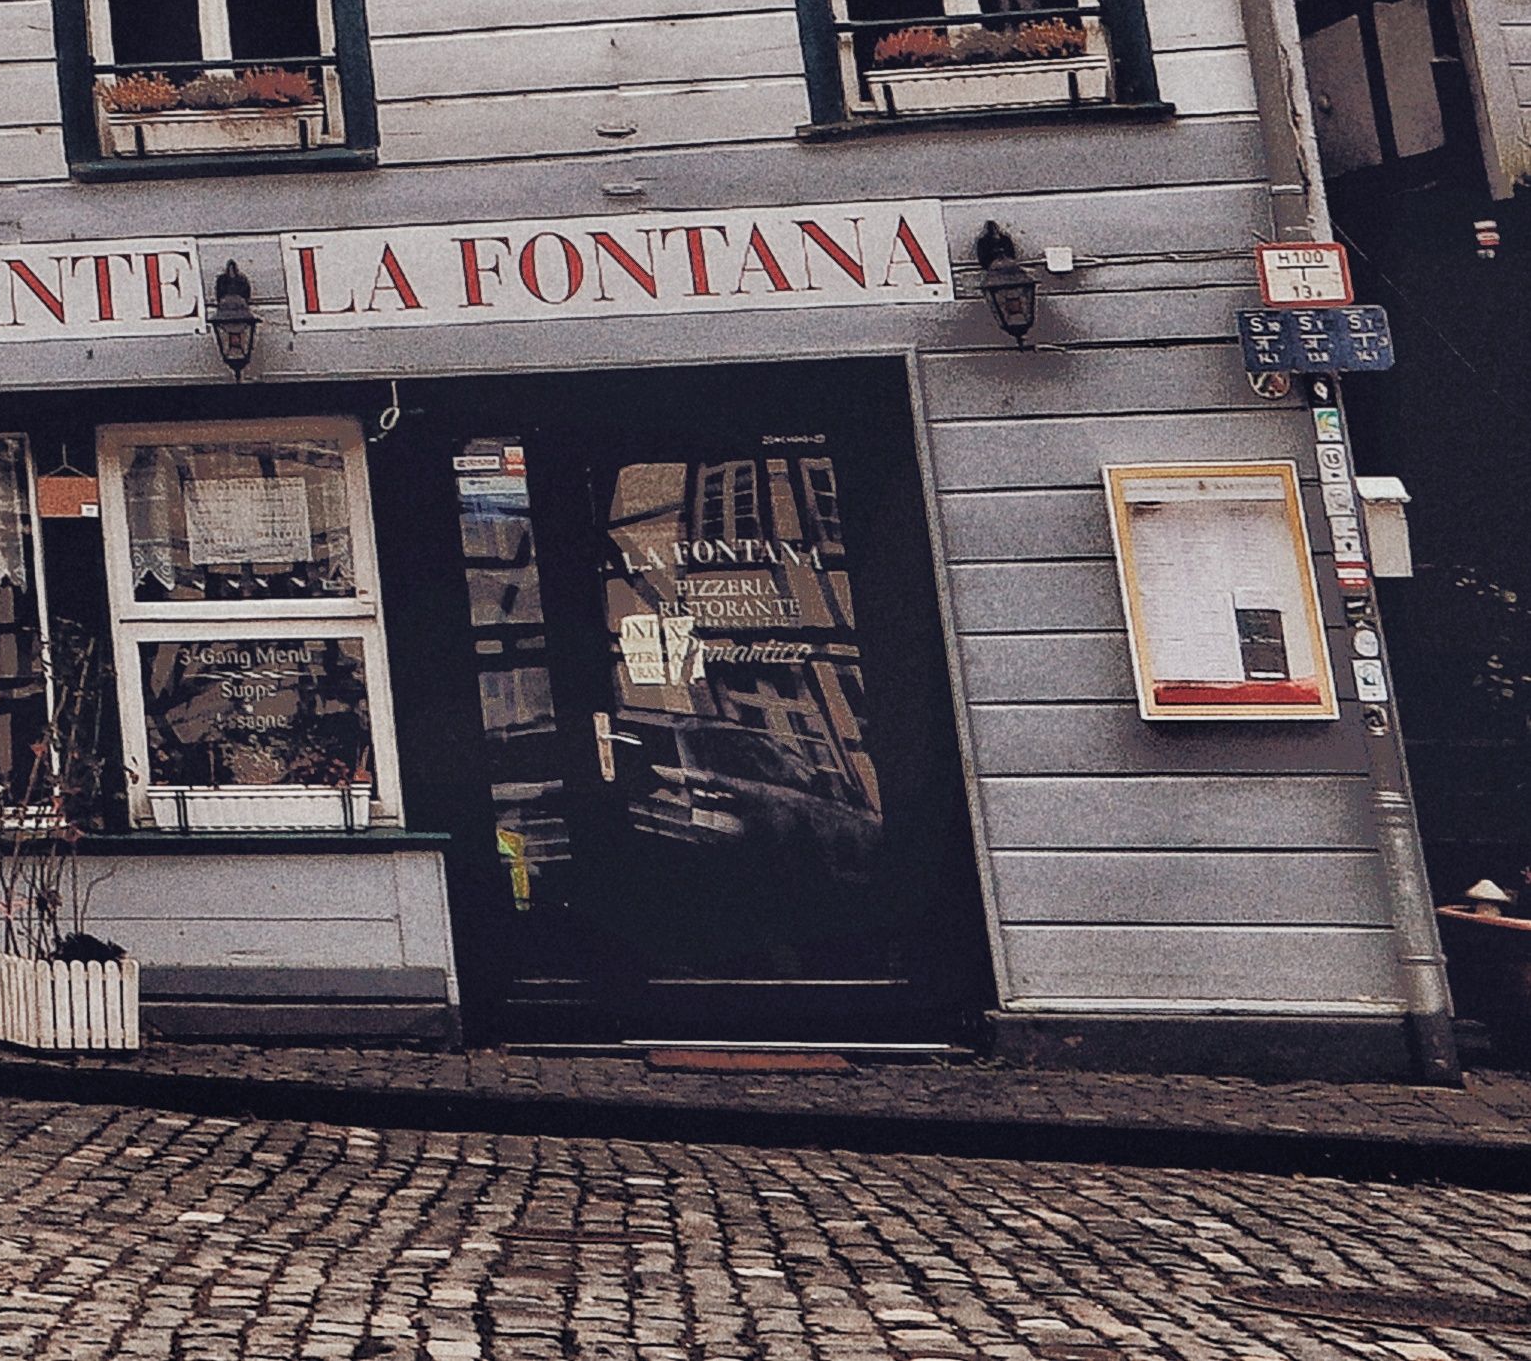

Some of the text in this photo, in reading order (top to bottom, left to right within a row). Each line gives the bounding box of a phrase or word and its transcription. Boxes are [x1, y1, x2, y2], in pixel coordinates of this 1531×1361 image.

[291, 214, 944, 315] LA FONTANA
[672, 538, 824, 571] FONTANA
[676, 579, 781, 597] PIZZERIA
[660, 598, 803, 618] RISTORANTE
[179, 647, 252, 669] 3-Gang
[221, 681, 278, 700] Suppe
